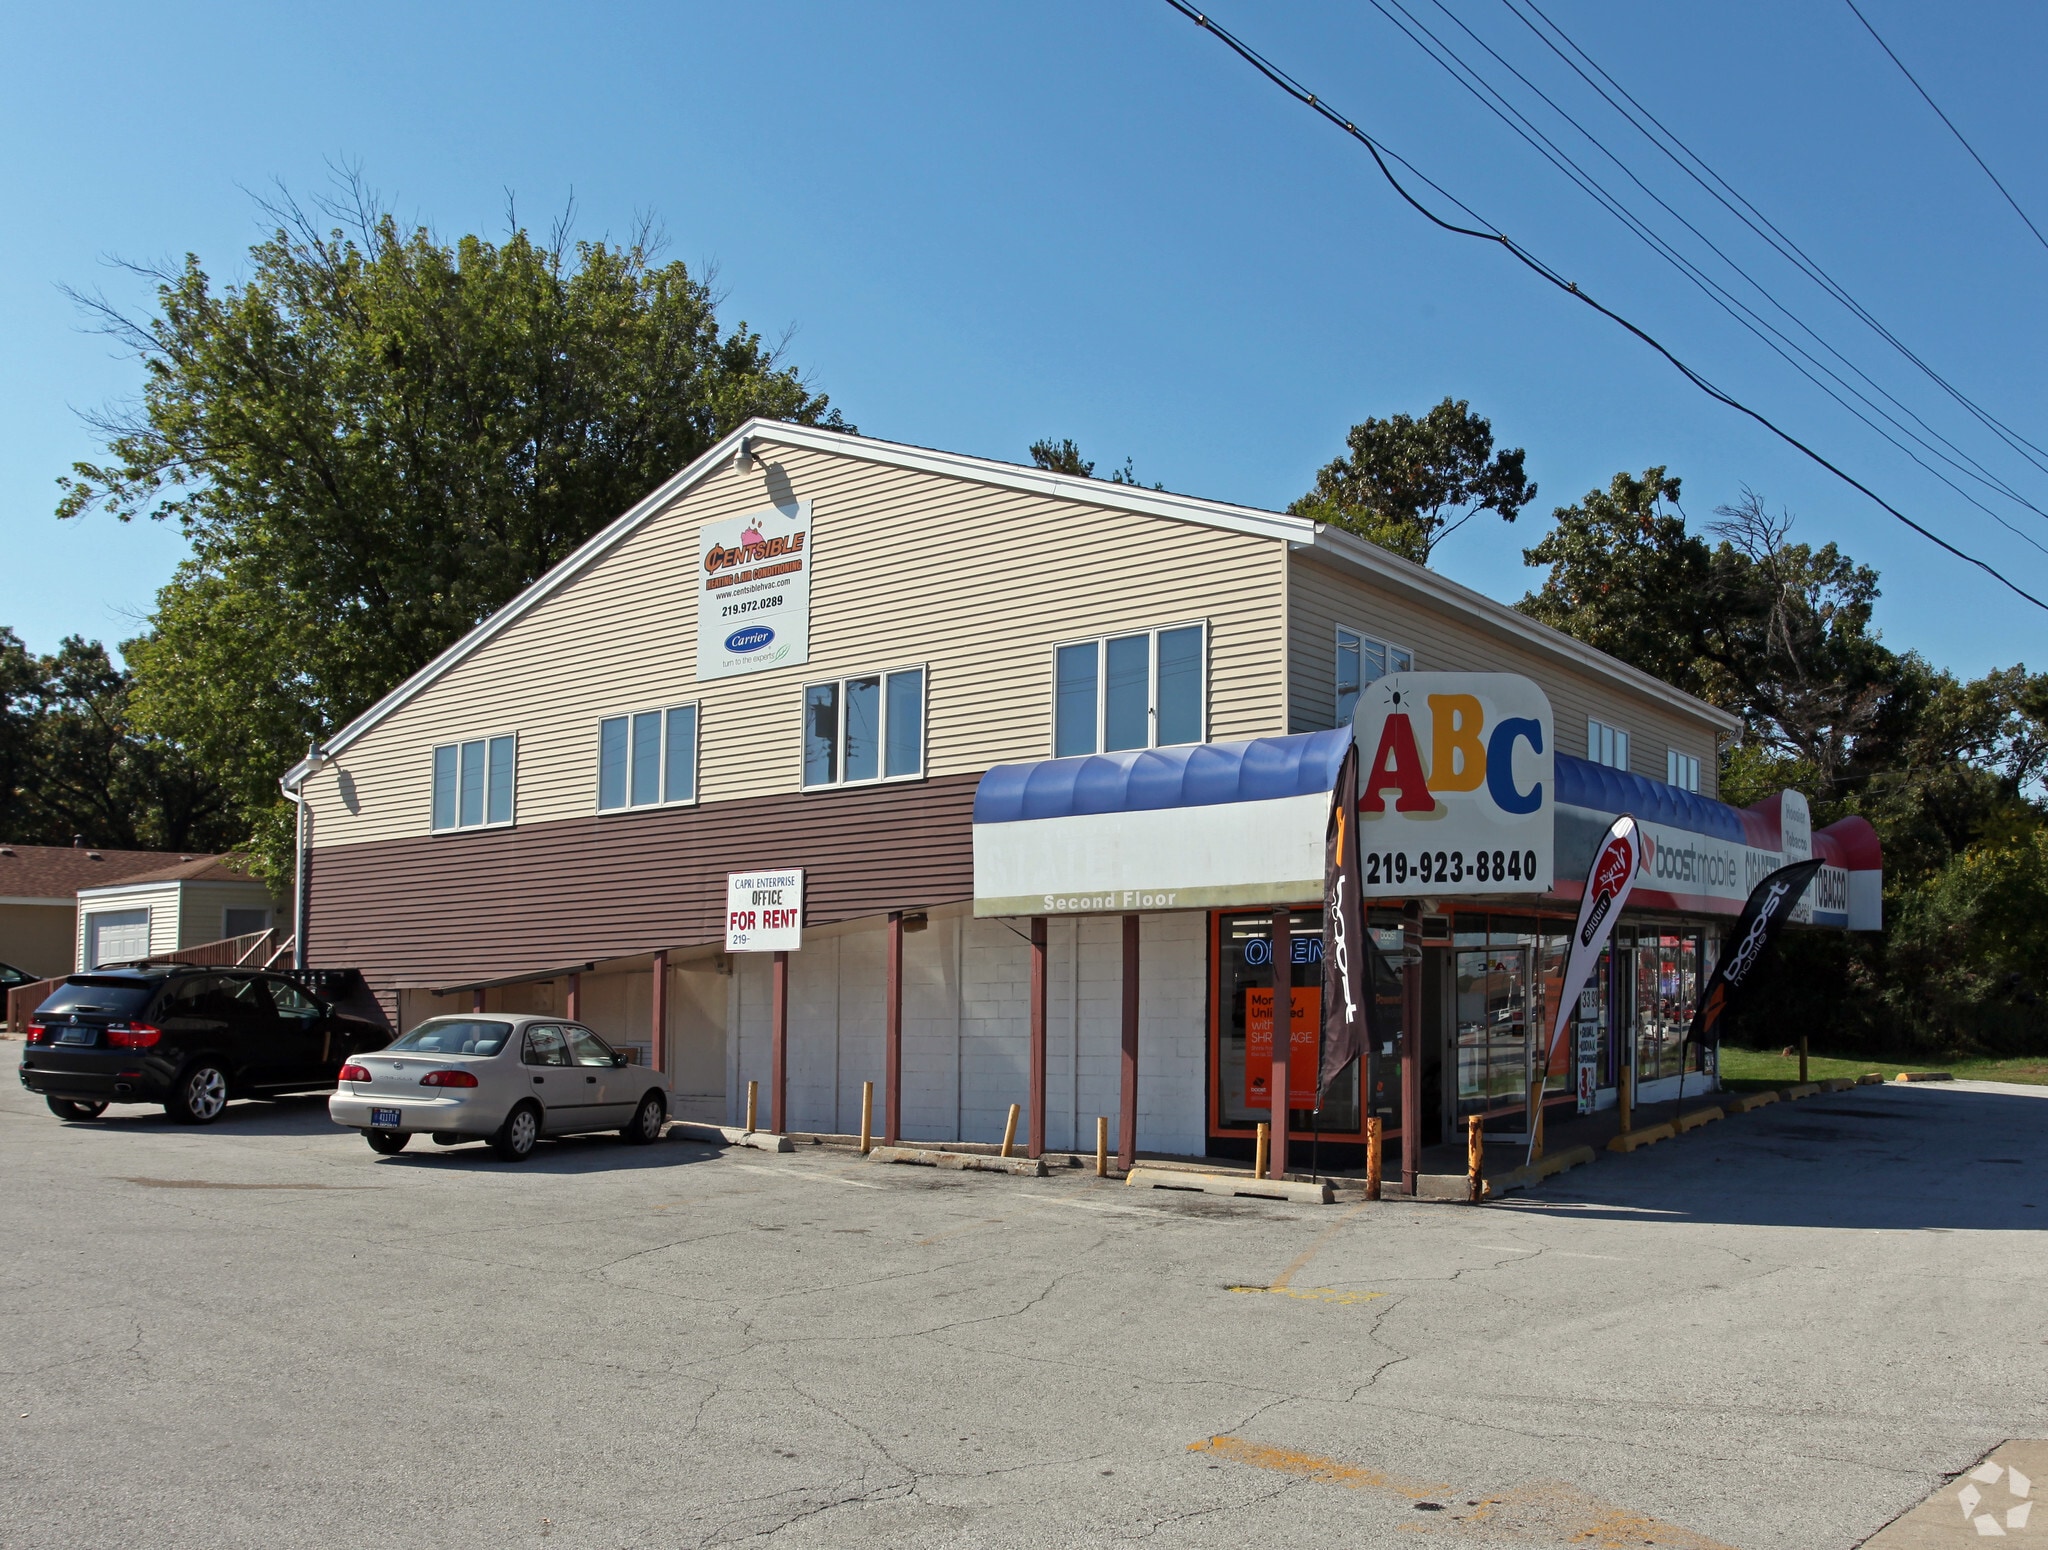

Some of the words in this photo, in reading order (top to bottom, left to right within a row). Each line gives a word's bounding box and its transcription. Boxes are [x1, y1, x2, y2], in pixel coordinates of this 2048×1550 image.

[706, 573, 734, 591] HEATING
[734, 572, 740, 584] &
[740, 569, 753, 584] AIR
[753, 559, 802, 580] CONDITIONING
[716, 578, 791, 600] www.centsiblehvac.com
[722, 595, 783, 617] 219.972.0289
[731, 632, 769, 647] Carrier
[722, 658, 735, 668] turn
[735, 658, 741, 666] to
[742, 656, 753, 664] the
[753, 652, 776, 663] experts
[1359, 694, 1544, 814] ABC
[1785, 803, 1806, 824] Hoosier
[1785, 830, 1808, 851] Tobacco
[1366, 850, 1537, 884] 219-923-8840
[1656, 834, 1696, 883] boost
[735, 879, 755, 889] CAPRI
[757, 876, 795, 888] ENTERPRISE
[1815, 865, 1846, 910] TOBACCO
[752, 890, 783, 906] OFFICE
[1043, 891, 1116, 910] Second
[1123, 891, 1178, 907] Floor
[730, 911, 757, 931] FOR
[763, 909, 798, 929] RENT
[1722, 880, 1791, 981] boost
[1244, 938, 1323, 965] OEN
[1733, 932, 1767, 987] mobile
[1252, 1008, 1304, 1018] Unlied
